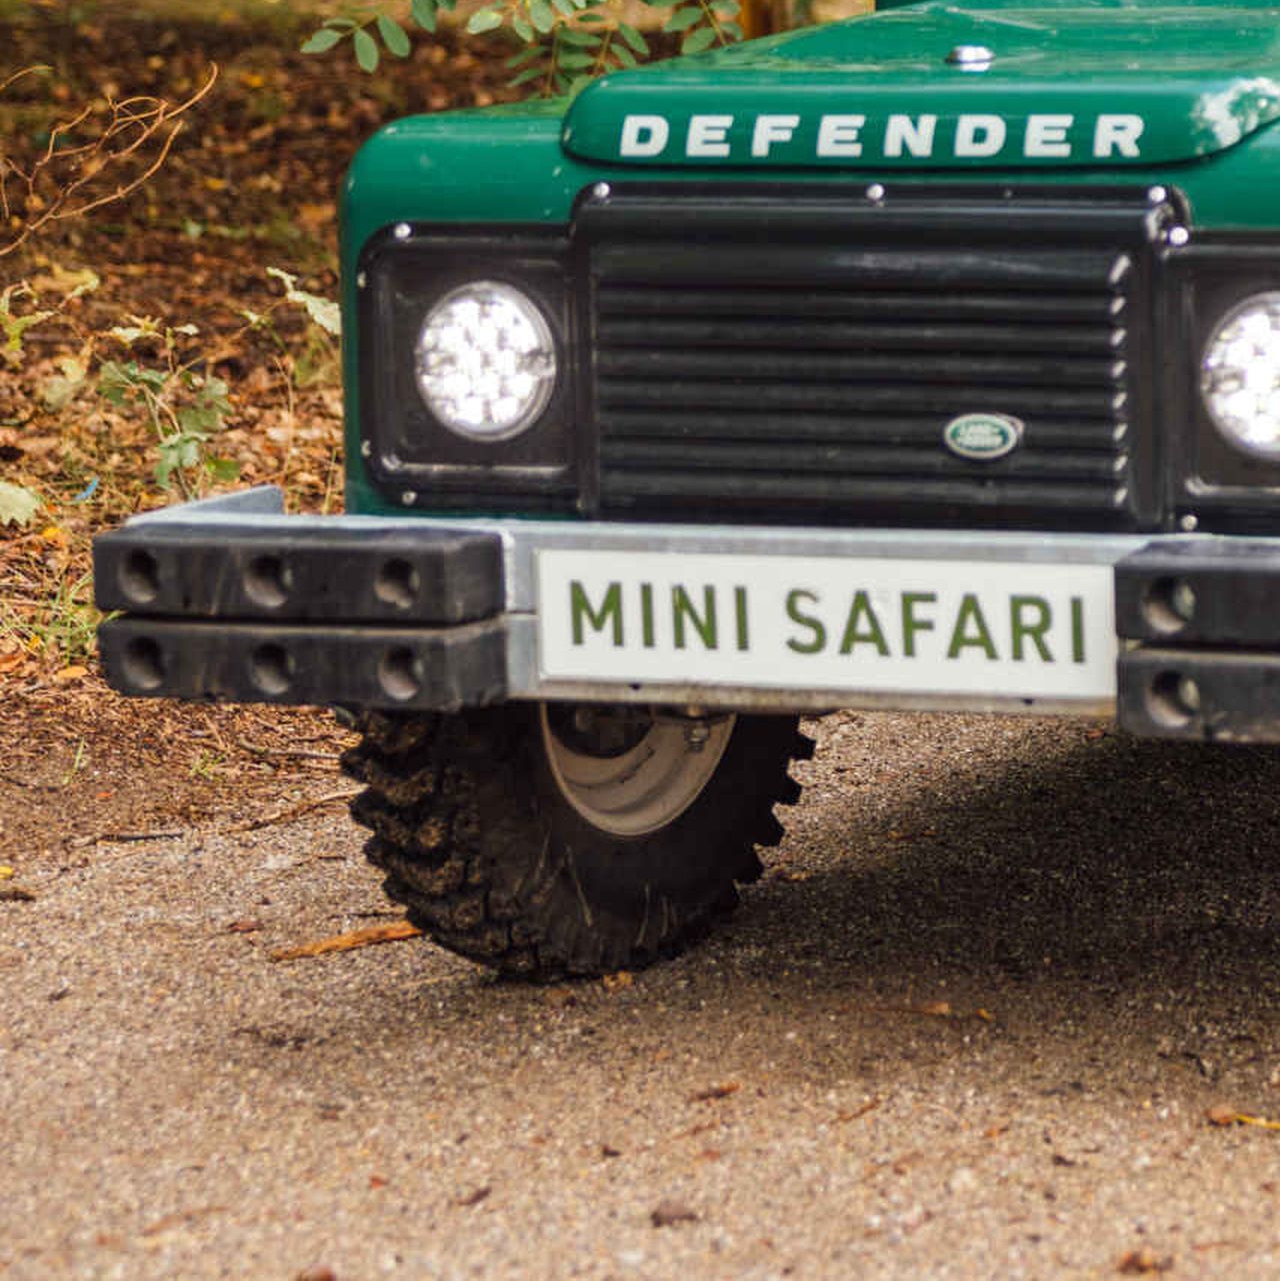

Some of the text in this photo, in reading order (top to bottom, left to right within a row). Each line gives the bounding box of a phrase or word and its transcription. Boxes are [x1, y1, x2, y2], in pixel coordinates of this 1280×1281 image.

[619, 114, 1145, 157] DEFENDER
[568, 579, 1087, 665] MINI SAFARI
